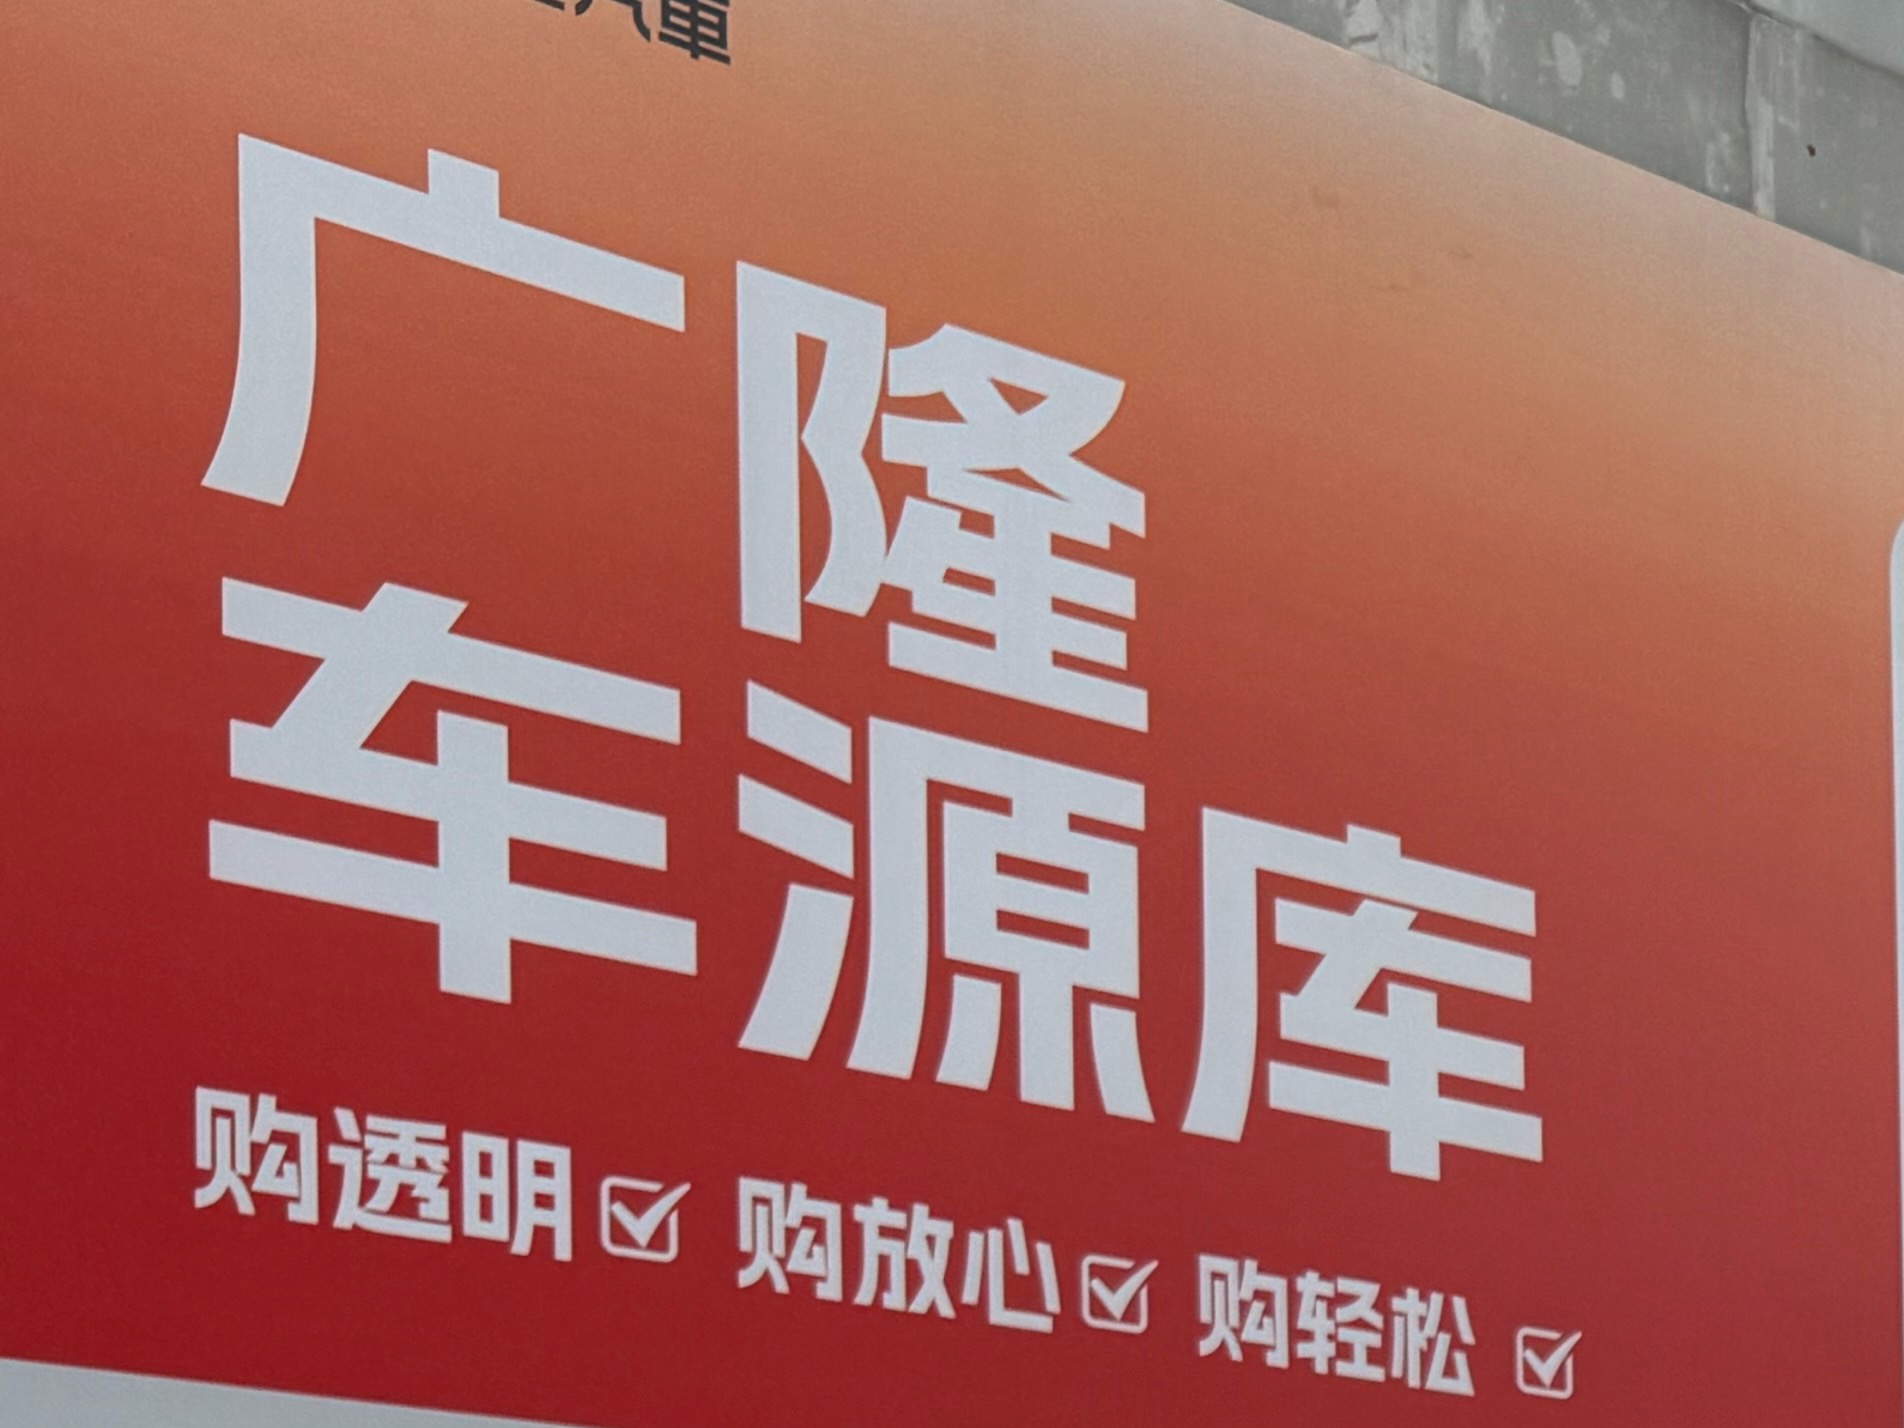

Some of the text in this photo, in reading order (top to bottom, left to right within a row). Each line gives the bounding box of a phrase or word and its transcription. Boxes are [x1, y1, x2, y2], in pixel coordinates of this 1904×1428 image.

[200, 133, 1148, 733] 广隆
[209, 576, 1542, 1181] 车源库
[195, 1085, 1477, 1397] 购透明 购放心 购轻松
